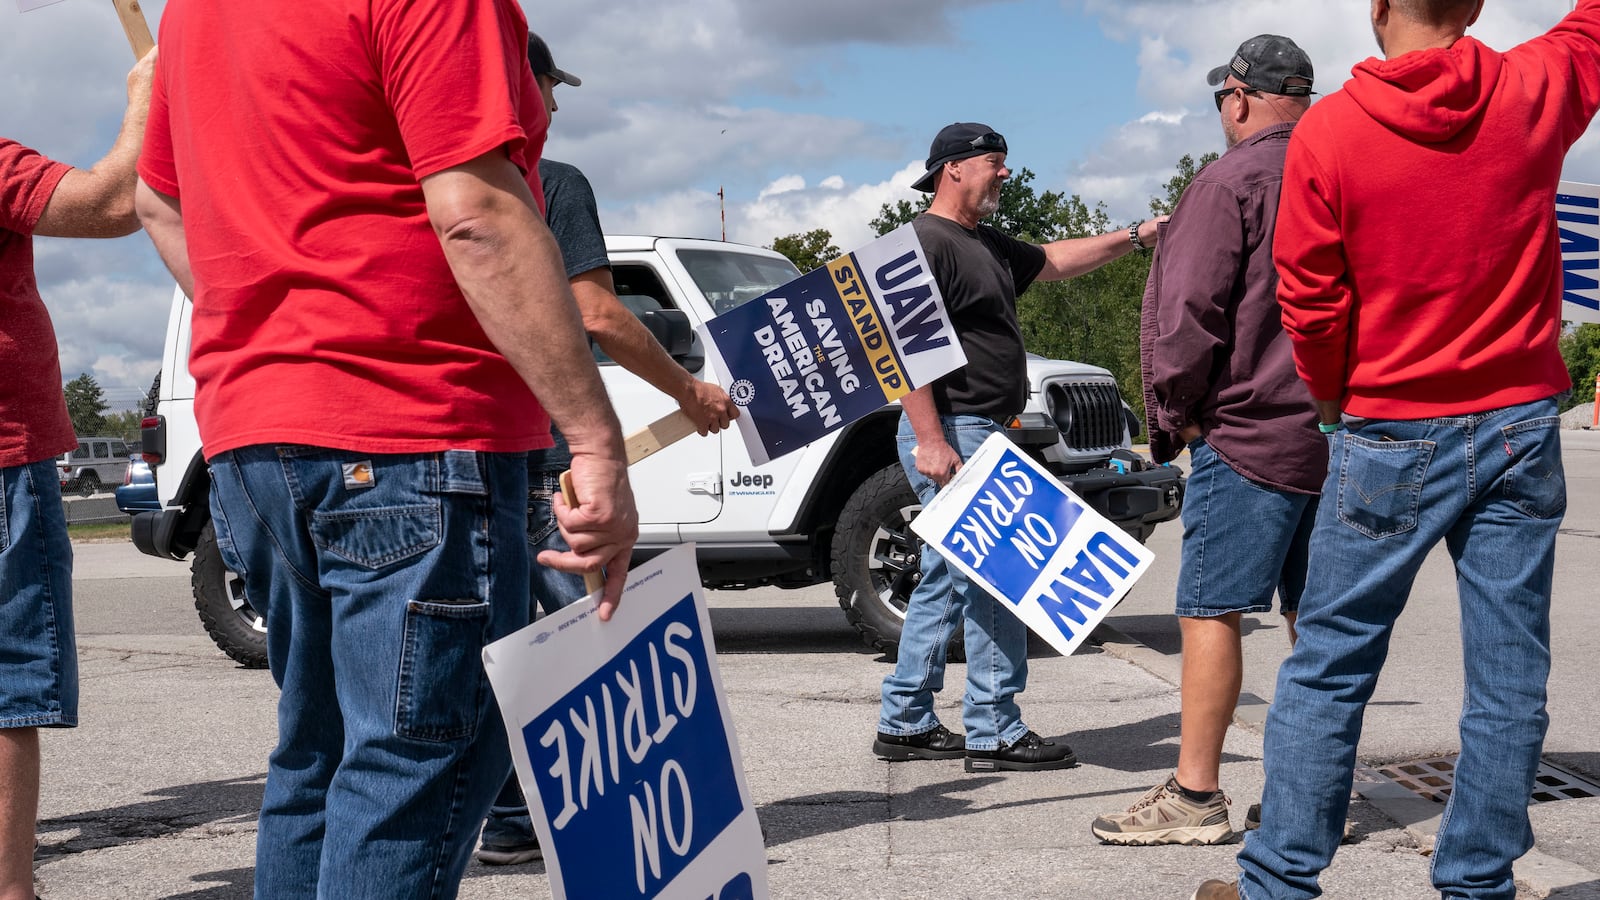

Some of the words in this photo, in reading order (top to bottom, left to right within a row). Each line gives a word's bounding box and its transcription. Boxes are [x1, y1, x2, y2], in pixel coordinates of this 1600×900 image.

[805, 298, 860, 395] SAVING
[812, 344, 826, 363] THE
[834, 265, 883, 350] STAND
[875, 354, 902, 390] UP
[875, 249, 951, 356] UAW
[753, 324, 810, 419] DREAM
[766, 297, 842, 429] AMERICAN
[730, 471, 774, 489] Jeep
[951, 461, 1034, 569] STRIKE
[1010, 512, 1058, 570] ON
[1036, 531, 1141, 642] UAW
[539, 621, 697, 830] STRIKE
[629, 759, 694, 894] ON
